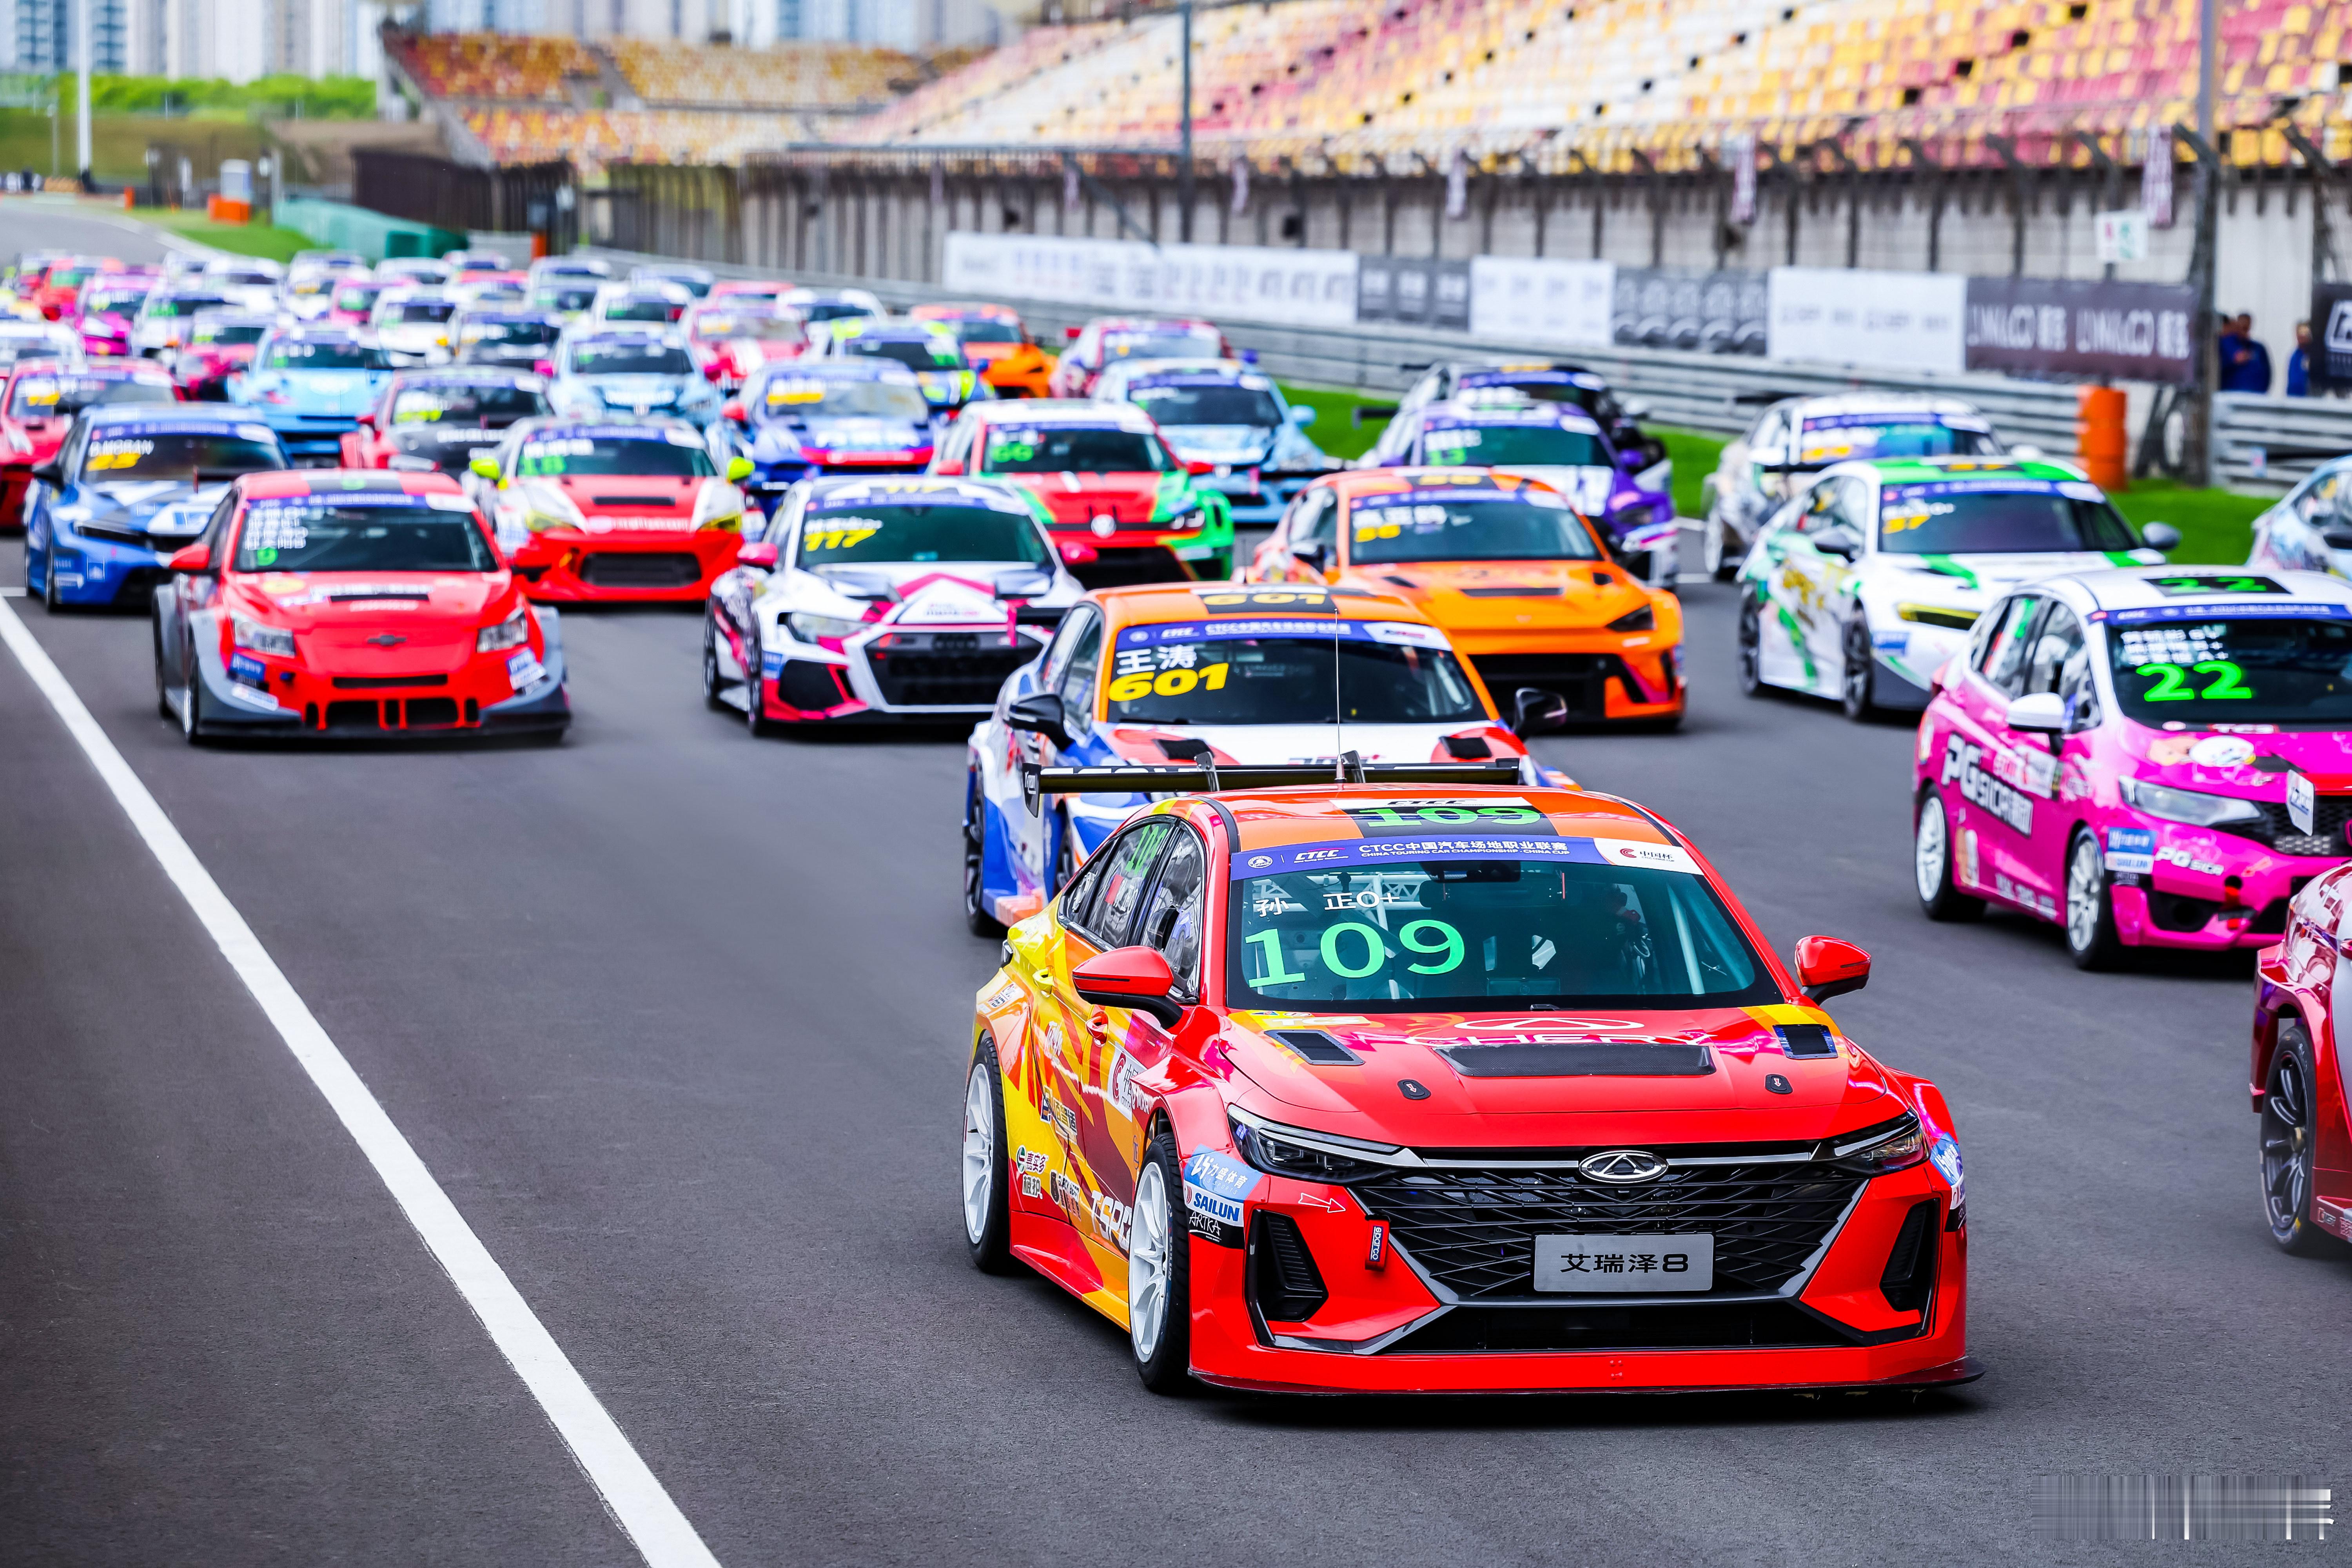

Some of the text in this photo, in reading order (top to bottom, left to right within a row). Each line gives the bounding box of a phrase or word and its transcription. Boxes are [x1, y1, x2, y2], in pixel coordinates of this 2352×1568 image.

[2158, 576, 2267, 593] 22
[1116, 644, 1197, 675] 王涛
[1109, 663, 1229, 702] 601
[2135, 660, 2252, 702] 22
[1359, 808, 1541, 827] 109
[1295, 850, 1339, 861] CTCC
[1359, 841, 1568, 853] CTCC中国汽车场地职业联赛
[1256, 897, 1290, 917] 孙
[1245, 919, 1465, 988] 109
[1026, 1152, 1046, 1173] 嘉实多
[1207, 1163, 1249, 1189] 力盛体育
[1213, 1180, 1238, 1195] SPORTS
[1193, 1192, 1240, 1222] SAILUN
[1189, 1211, 1221, 1236] ARTKA
[1372, 1227, 1382, 1260] sparco
[1560, 1253, 1689, 1274] 艾瑞泽8
